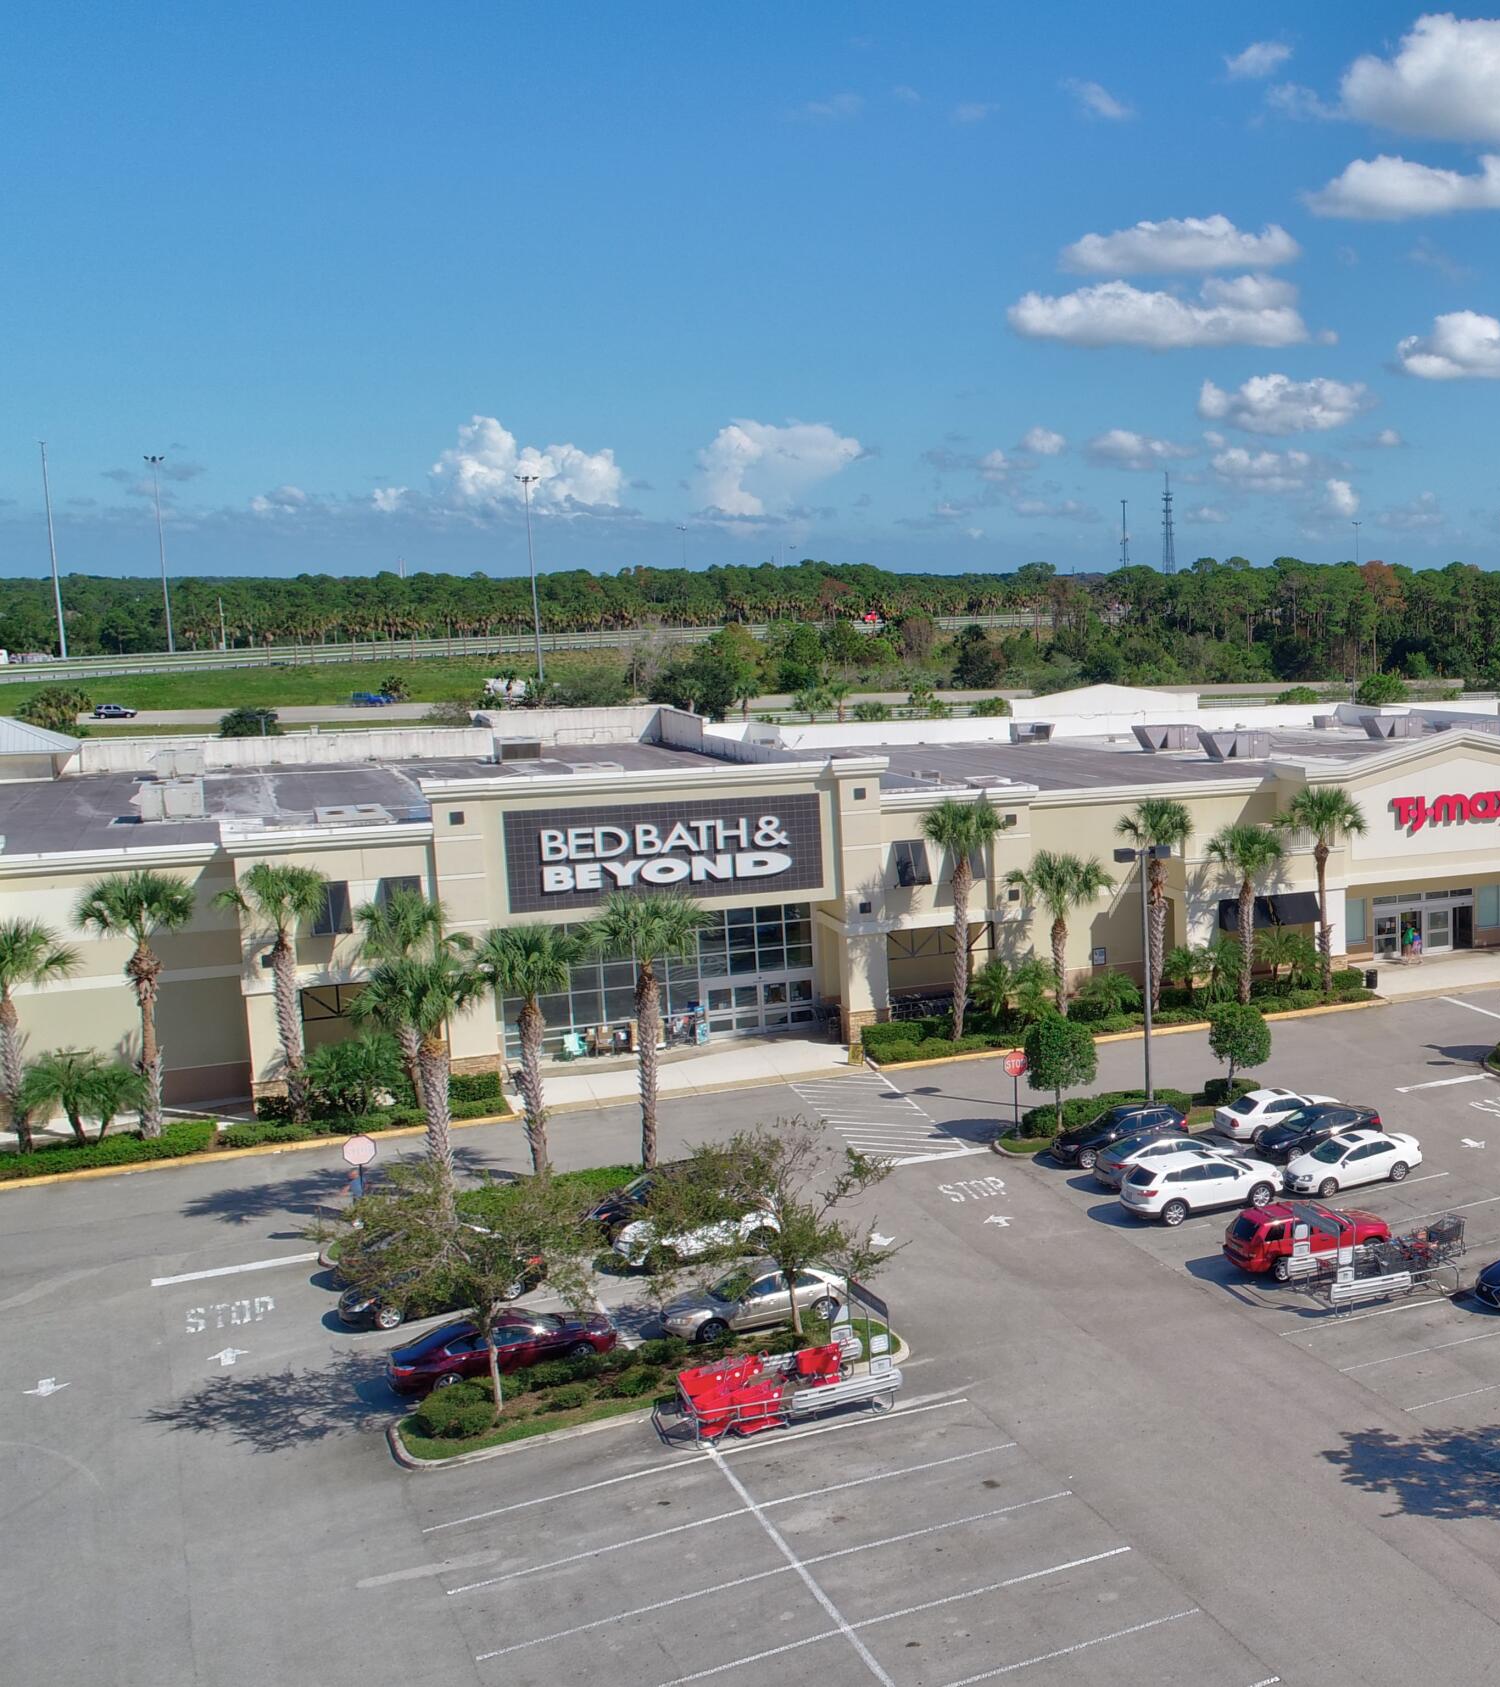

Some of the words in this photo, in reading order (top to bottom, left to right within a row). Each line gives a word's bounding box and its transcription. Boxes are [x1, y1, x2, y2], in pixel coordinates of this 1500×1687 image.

[541, 827, 629, 862] BED
[636, 818, 748, 856] BATH
[754, 815, 790, 847] &
[542, 851, 792, 893] BEYOND
[1005, 1058, 1026, 1070] STOP
[937, 1176, 1006, 1202] STOP
[185, 1295, 275, 1334] STOP
